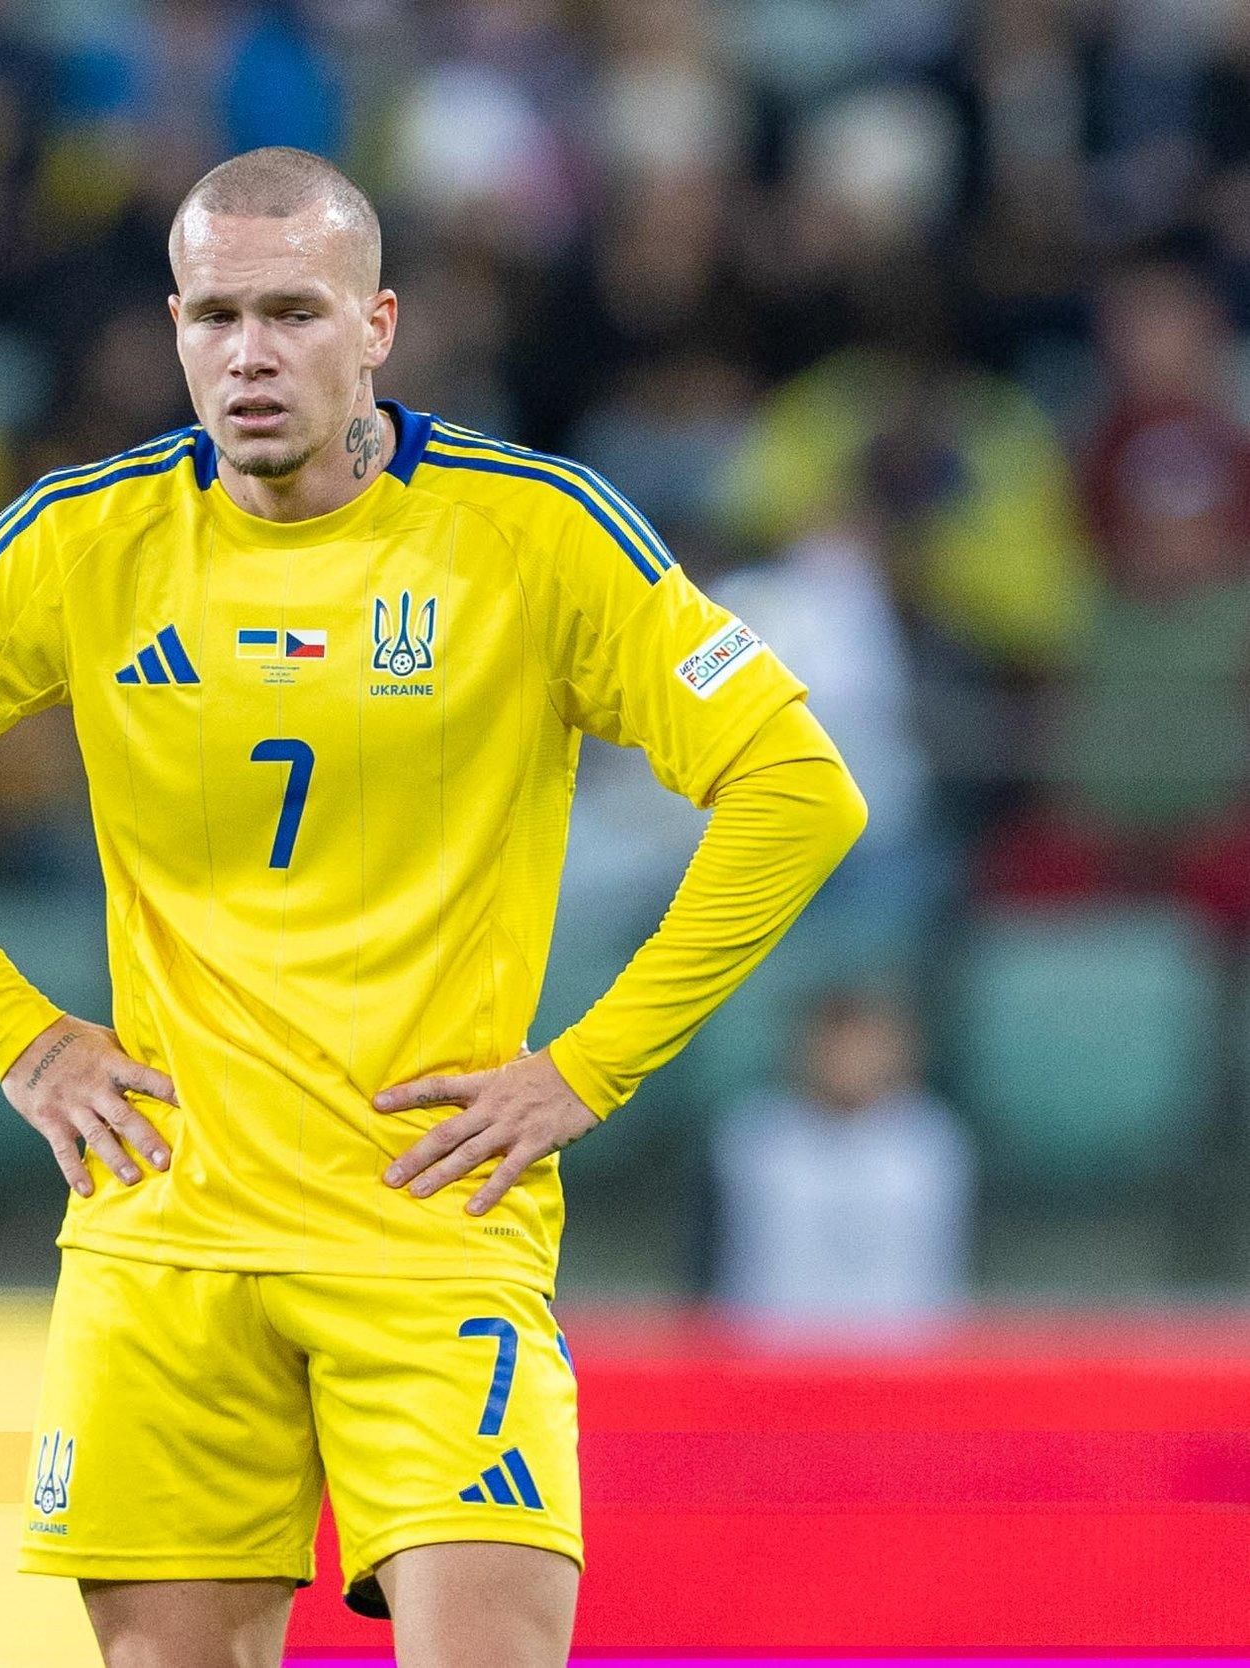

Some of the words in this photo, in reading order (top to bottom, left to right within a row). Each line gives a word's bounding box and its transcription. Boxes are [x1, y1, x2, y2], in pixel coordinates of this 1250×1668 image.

[370, 684, 434, 696] UKRAINE
[679, 655, 702, 676] UEFA
[250, 738, 315, 869] 7
[458, 1317, 518, 1435] 7
